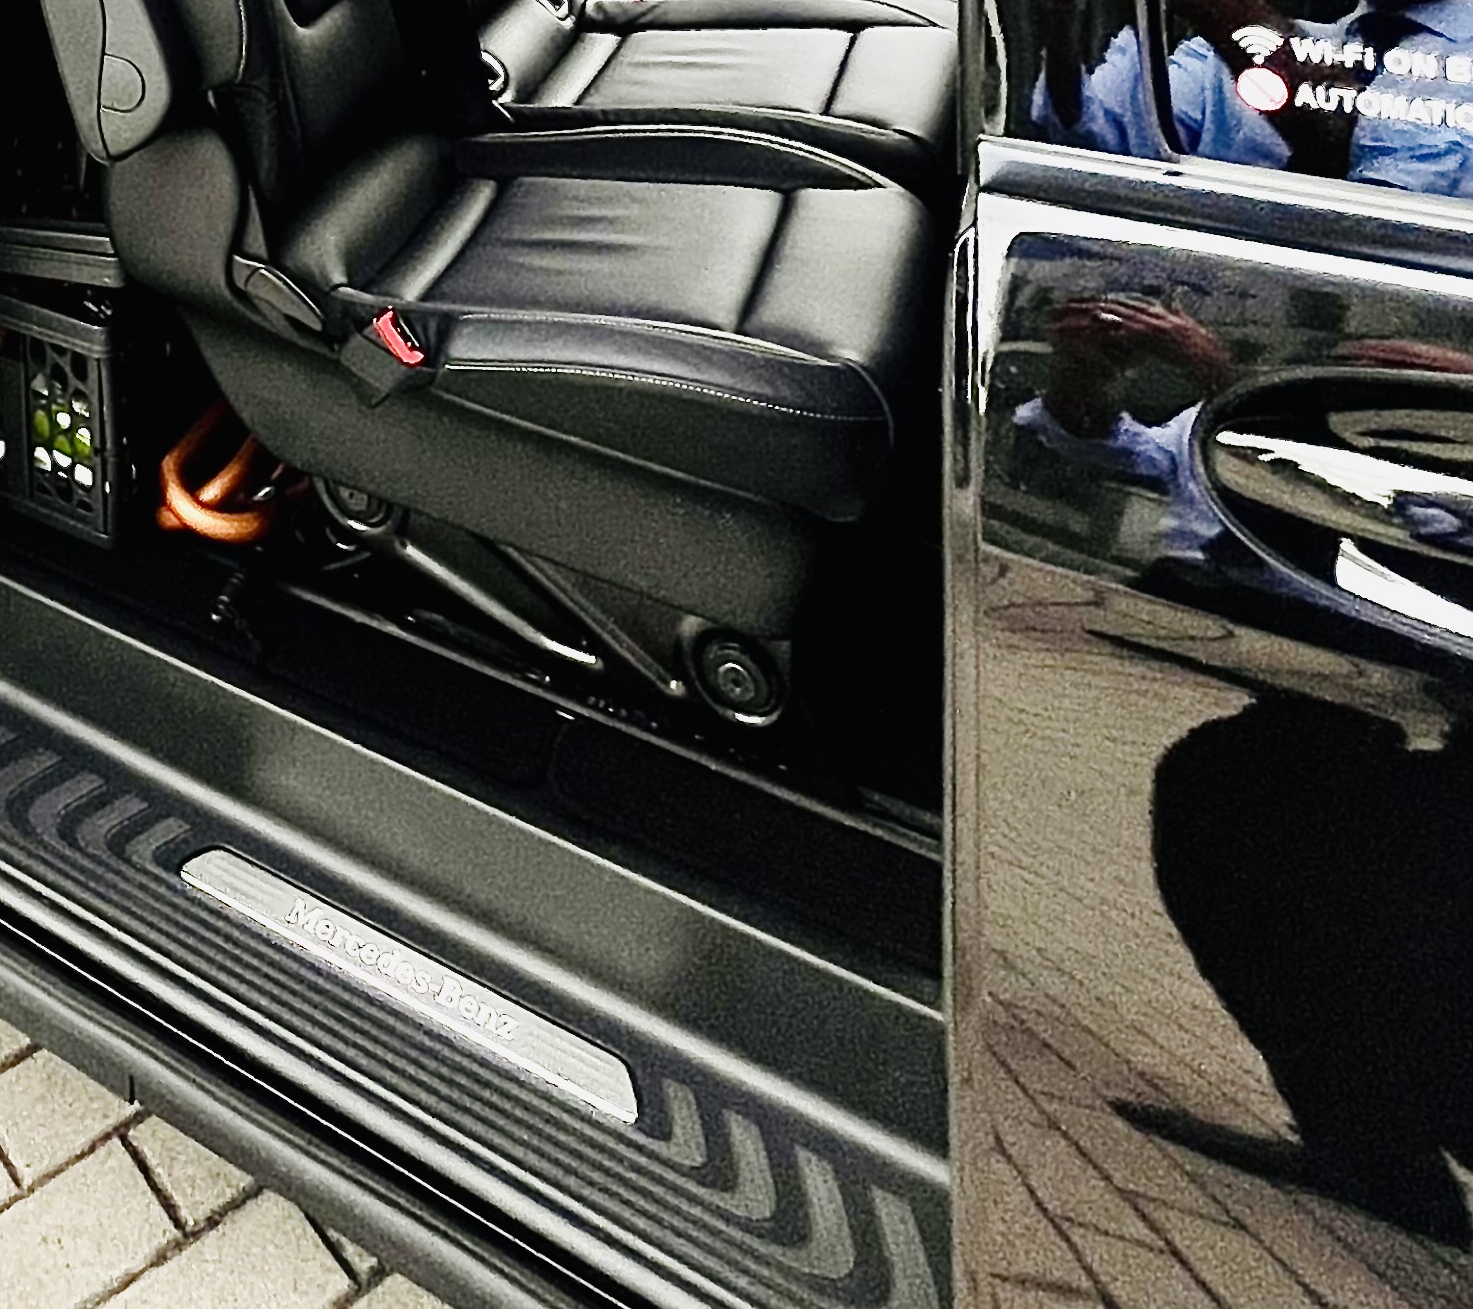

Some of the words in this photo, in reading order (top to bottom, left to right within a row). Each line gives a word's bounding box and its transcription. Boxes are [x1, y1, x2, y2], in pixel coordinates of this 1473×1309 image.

[1289, 36, 1375, 71] WI-FI
[1384, 47, 1438, 79] ON
[1445, 55, 1473, 84] B
[284, 897, 520, 1041] Mercedes-Benz
